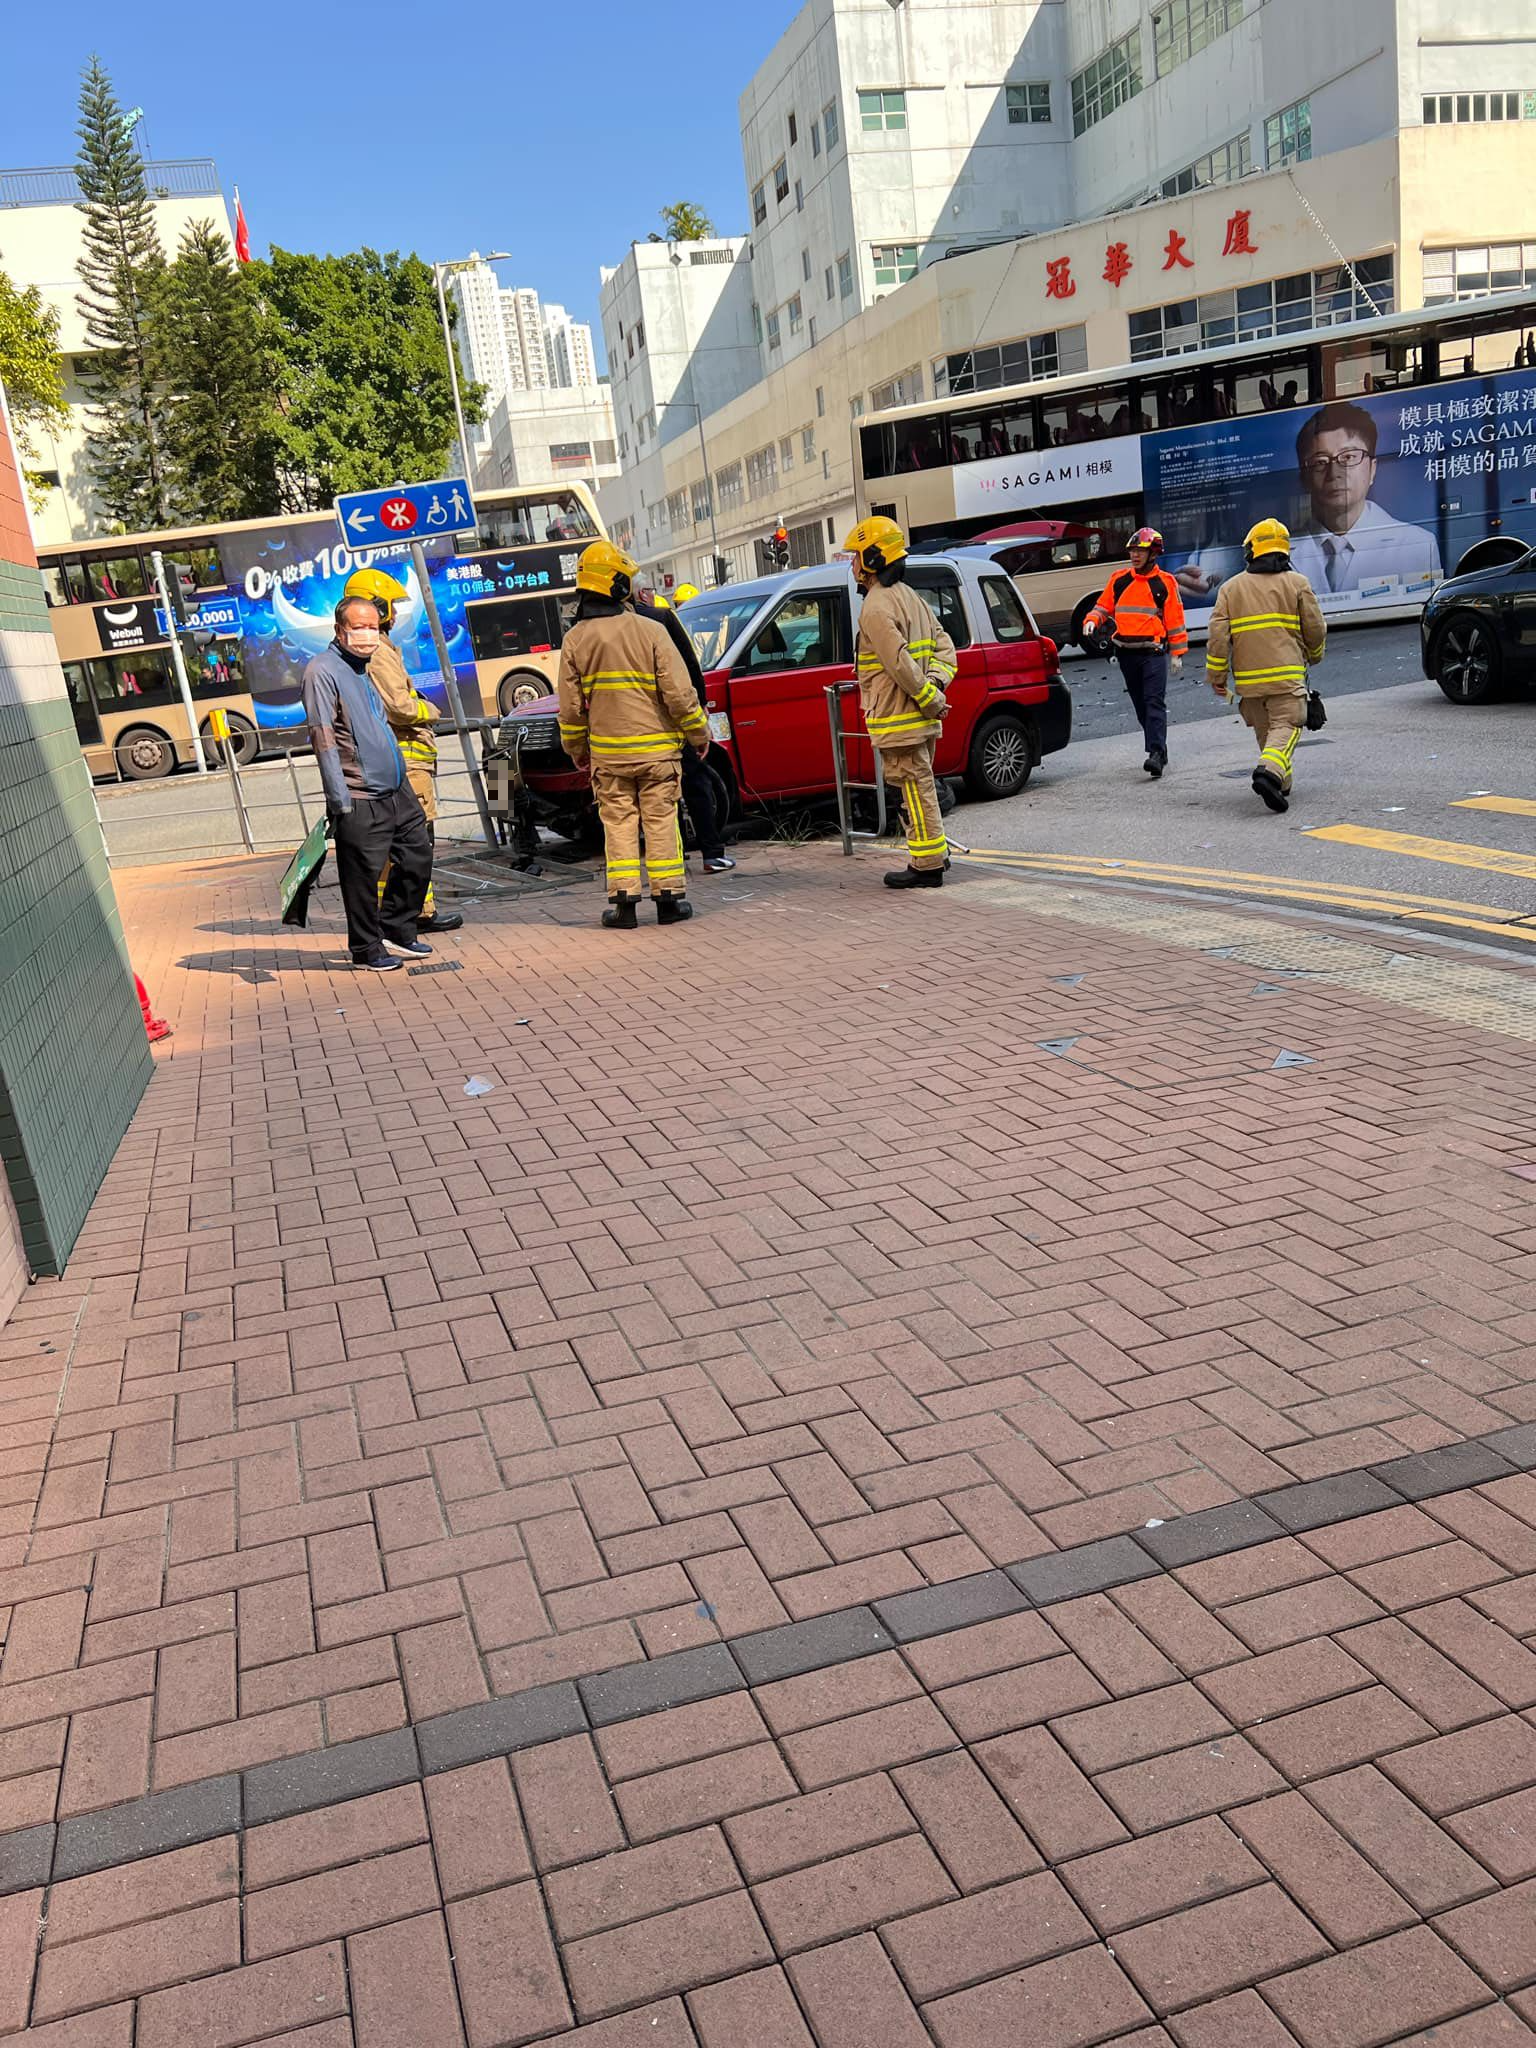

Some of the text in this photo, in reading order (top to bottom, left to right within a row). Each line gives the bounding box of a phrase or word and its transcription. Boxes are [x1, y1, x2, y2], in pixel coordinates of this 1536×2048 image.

[1398, 417, 1536, 458] 成就 SAGAM
[1002, 459, 1113, 490] SAGAMI 相模
[446, 563, 483, 581] 美港股
[109, 626, 143, 641] Webull
